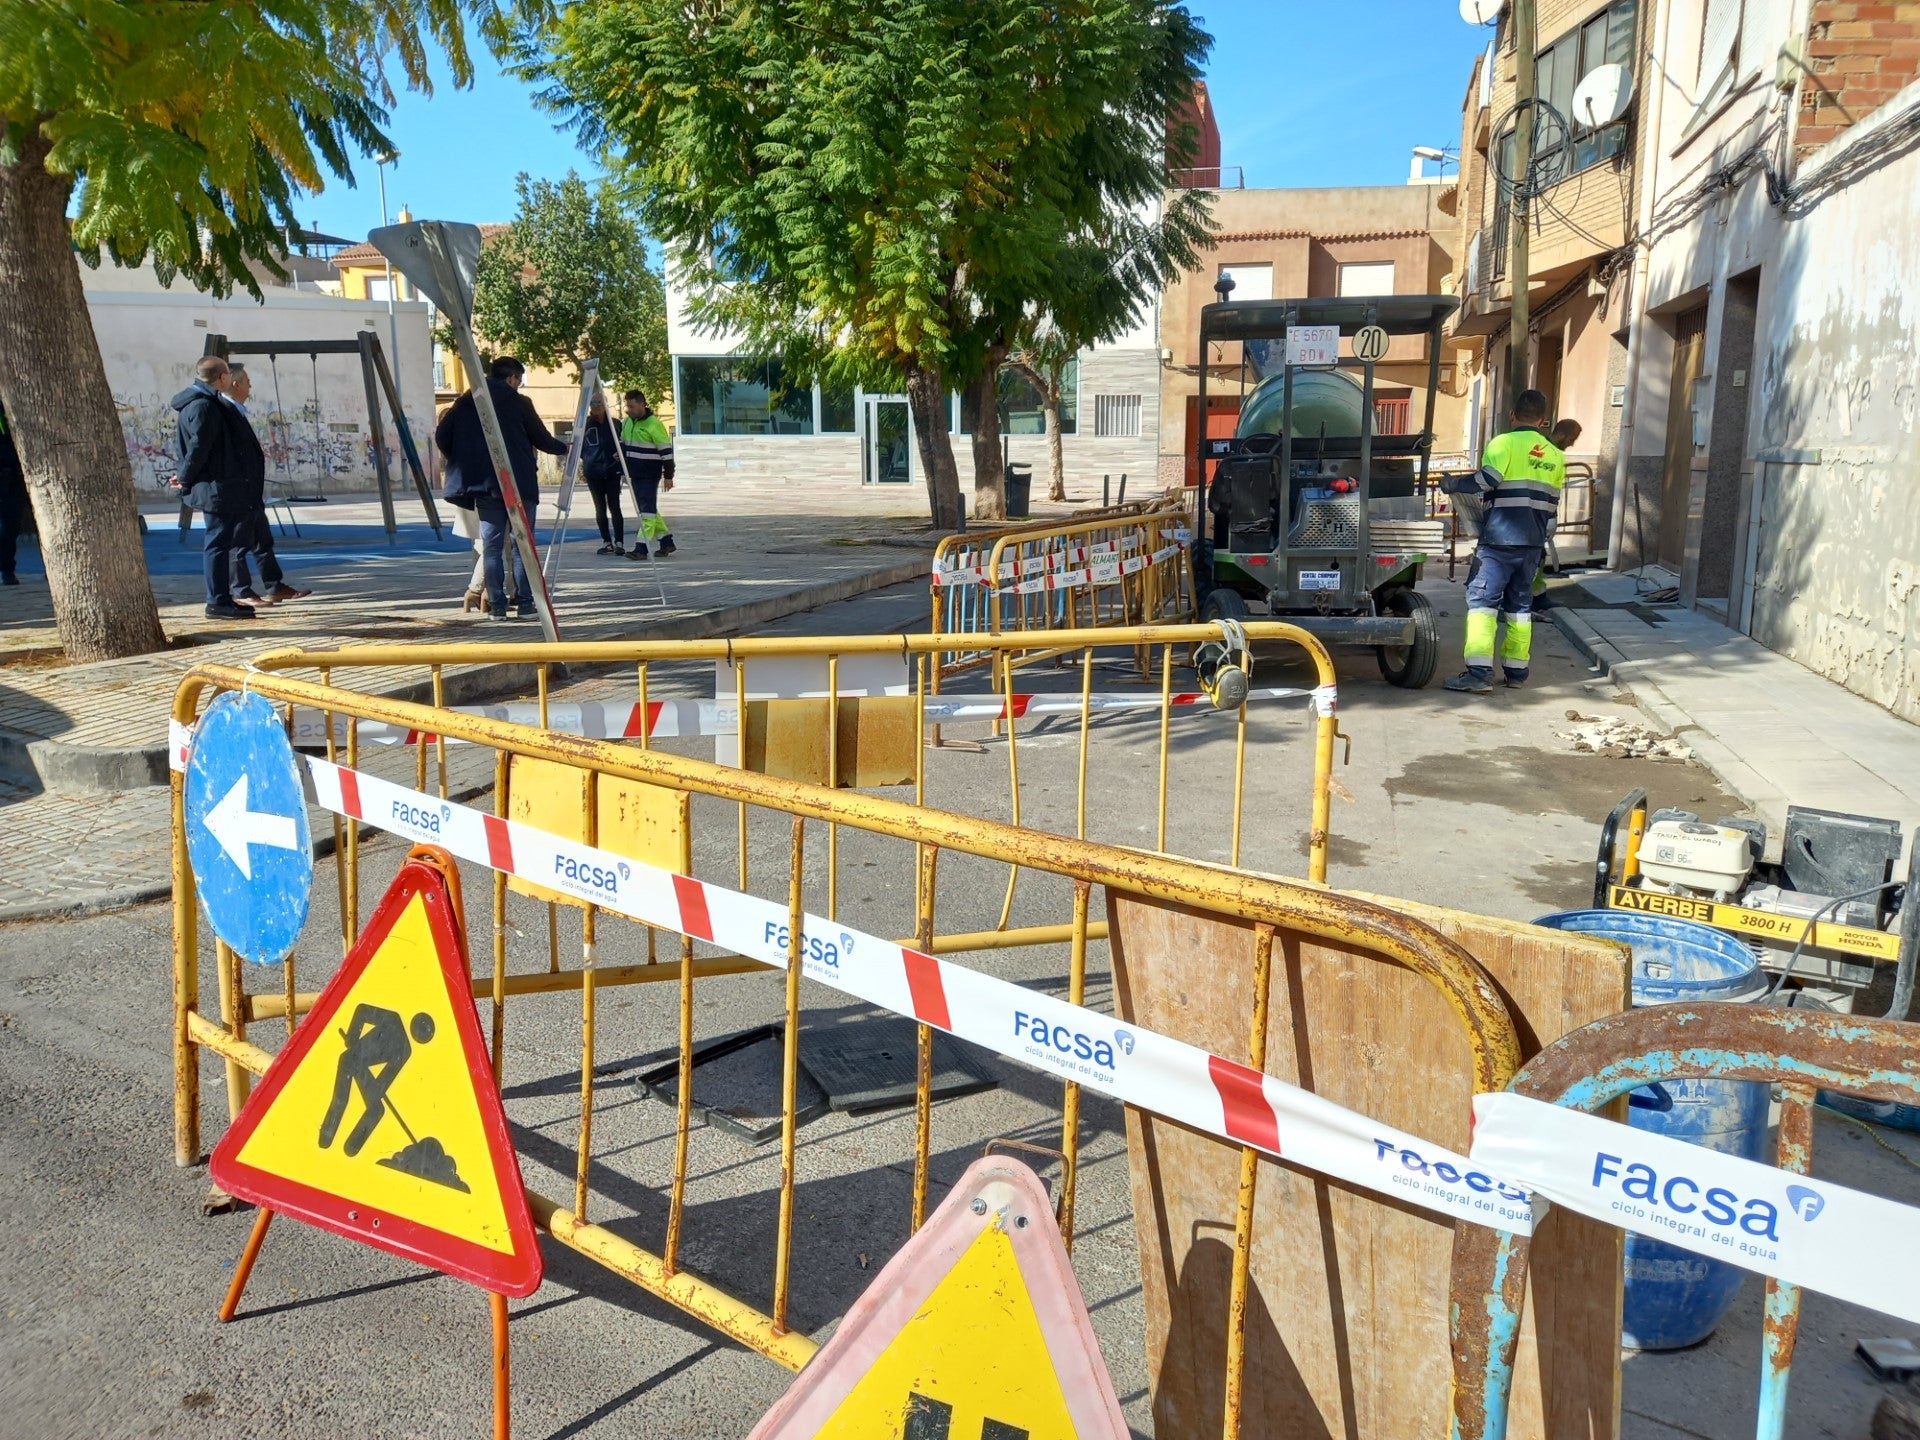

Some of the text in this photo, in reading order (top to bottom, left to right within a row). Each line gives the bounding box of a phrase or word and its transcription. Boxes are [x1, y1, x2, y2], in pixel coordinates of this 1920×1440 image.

[1303, 329, 1333, 341] 5670
[1361, 329, 1381, 358] 20
[392, 800, 440, 833] Facsa
[555, 854, 617, 893] Facsa
[1619, 891, 1709, 920] AYERBE
[1740, 914, 1791, 933] 3800 H
[1844, 931, 1879, 942] MOTOR
[1838, 937, 1883, 950] HONDA
[1015, 1010, 1115, 1070] Facsa
[1025, 1045, 1114, 1084] ciclo integral del agua
[1392, 1174, 1531, 1222] ciclo integral del agua
[1592, 1151, 1779, 1242] Facsa
[1611, 1200, 1777, 1261] ciclo integral del agua
